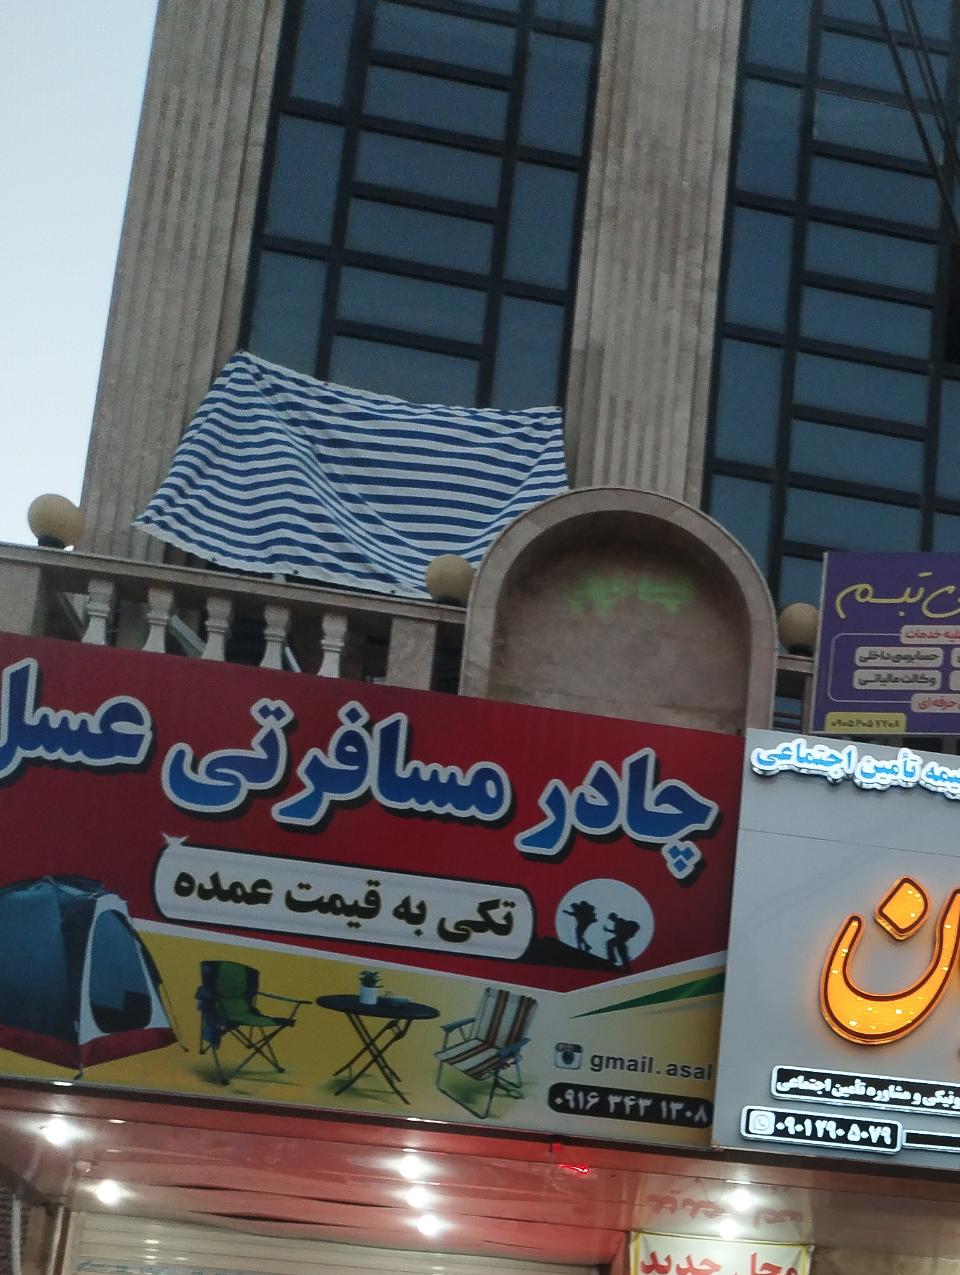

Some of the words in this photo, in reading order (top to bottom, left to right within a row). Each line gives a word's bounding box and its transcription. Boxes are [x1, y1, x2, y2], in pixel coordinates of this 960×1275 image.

[0, 658, 153, 780] عسل
[162, 699, 512, 826] مسافرتی
[751, 738, 857, 782] اجتماعی
[514, 747, 719, 880] چادر
[173, 871, 273, 906] عمده
[284, 879, 382, 930] قیمت
[391, 895, 427, 935] به
[437, 898, 515, 942] تکی
[555, 1088, 600, 1110] ۰۹۱۶
[607, 1094, 652, 1116] ۳۴۳
[660, 1100, 708, 1123] ۱۳۰۸
[776, 1075, 831, 1094] اجتماعی
[866, 1085, 911, 1102] مشاوره
[911, 1093, 922, 1105] و
